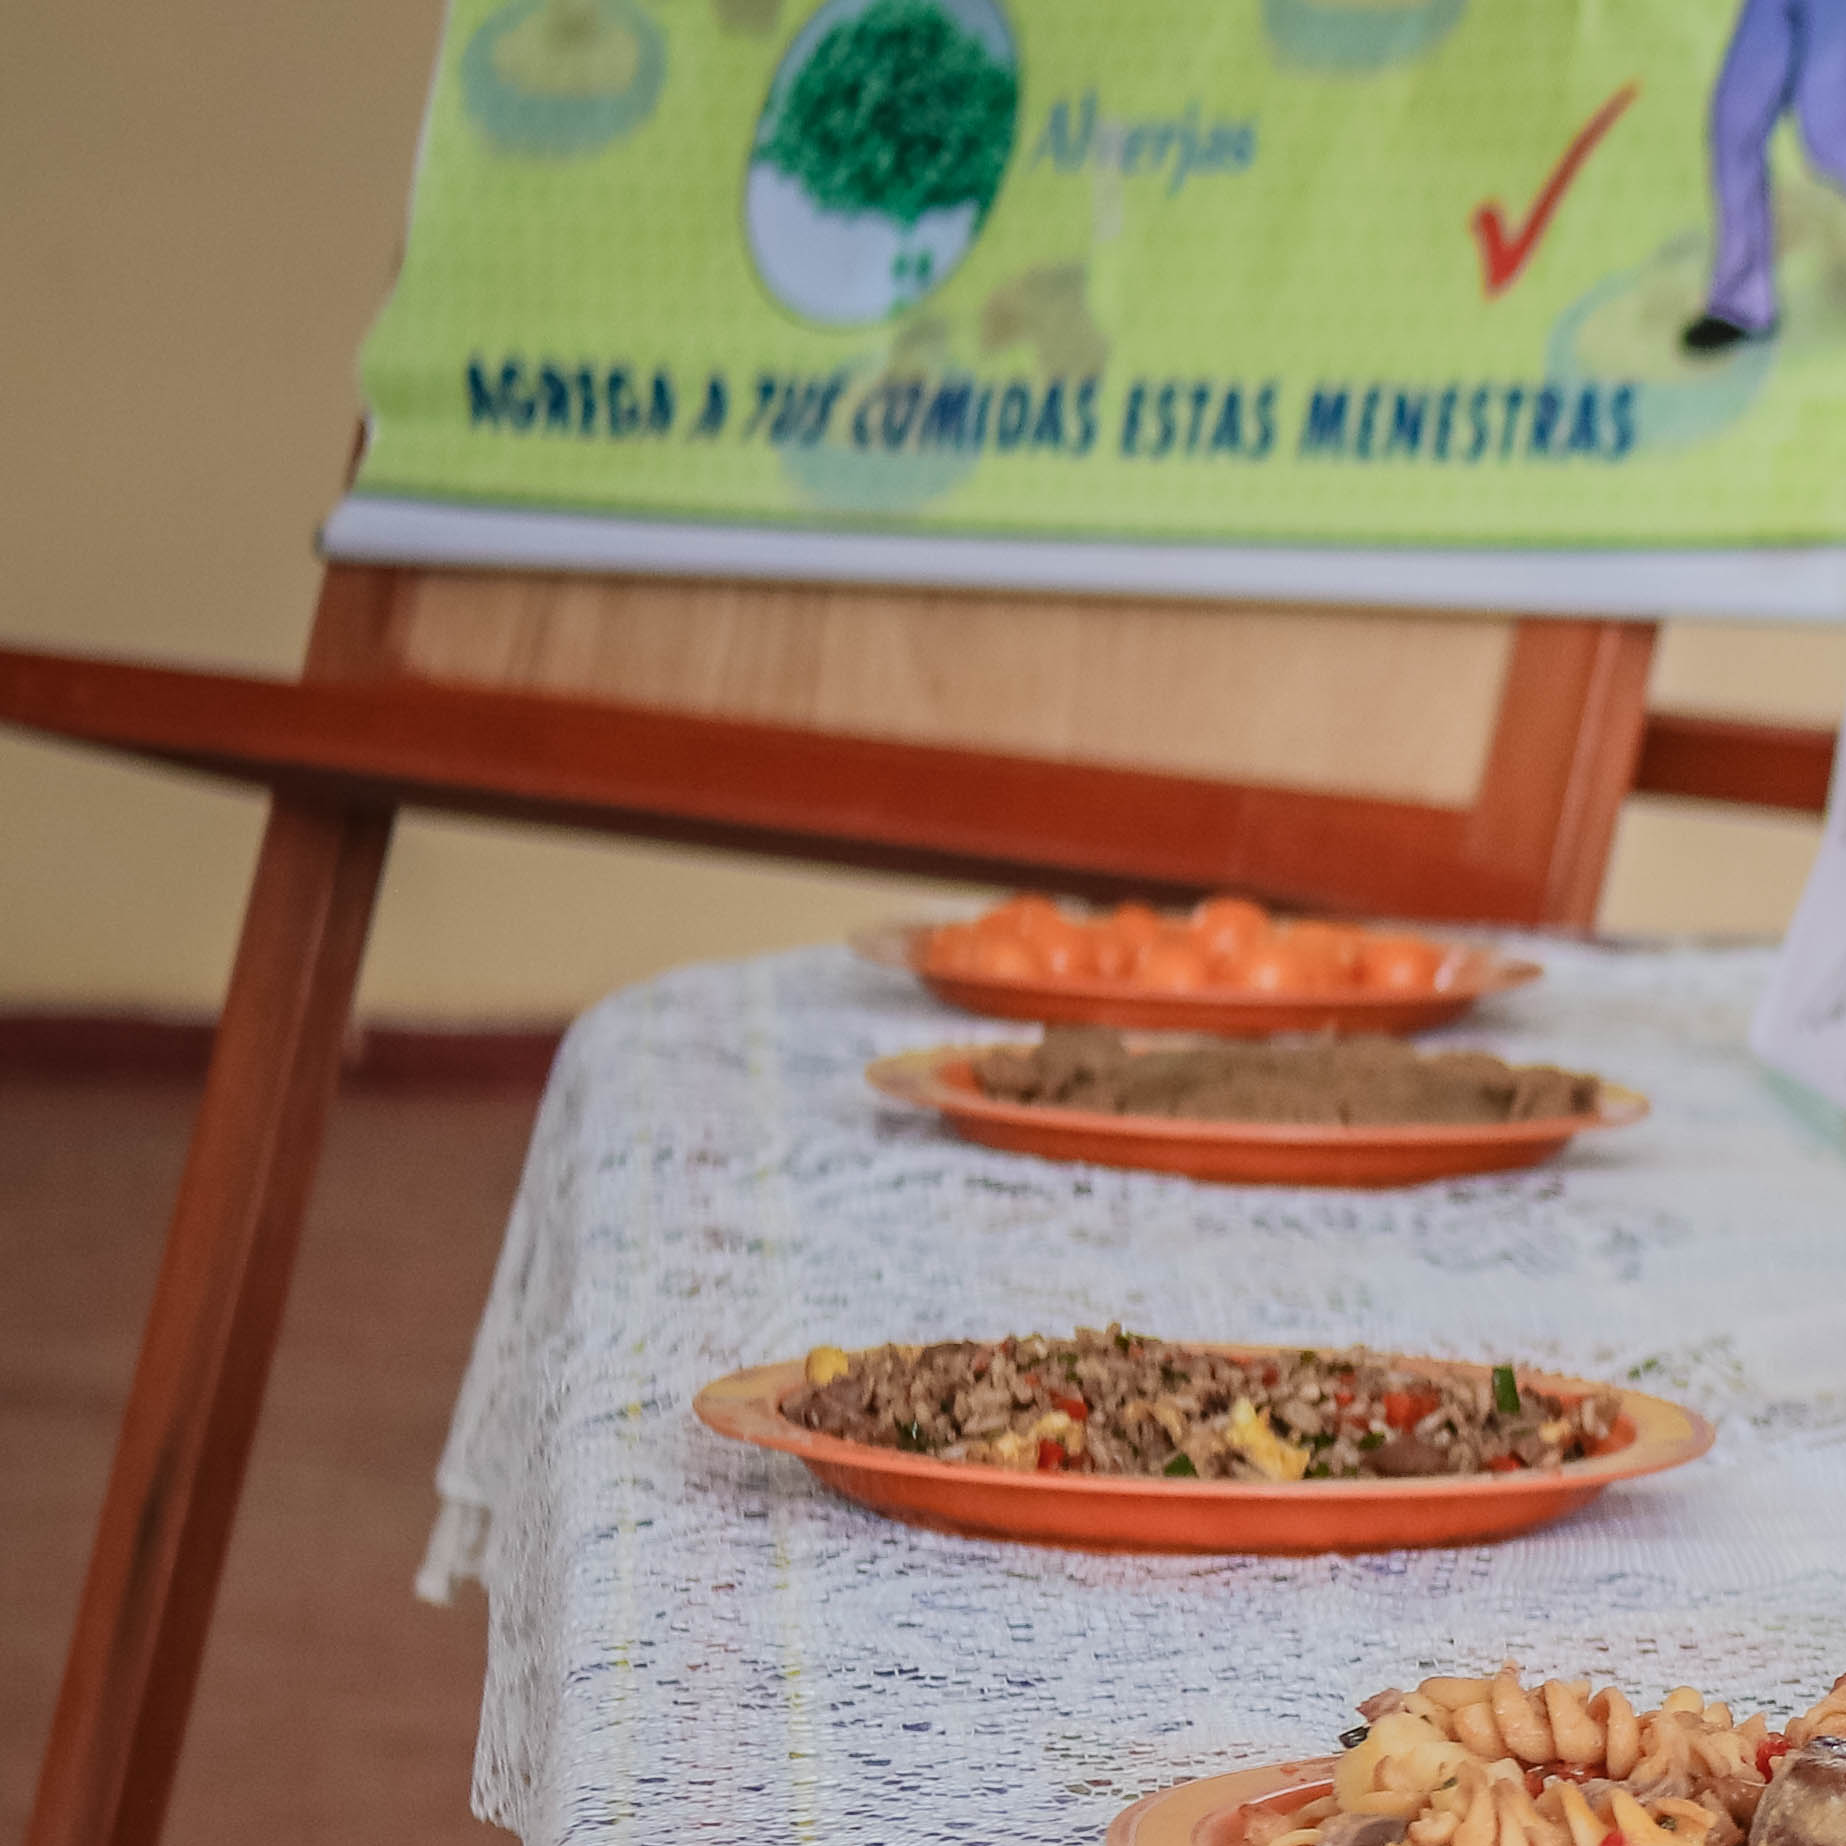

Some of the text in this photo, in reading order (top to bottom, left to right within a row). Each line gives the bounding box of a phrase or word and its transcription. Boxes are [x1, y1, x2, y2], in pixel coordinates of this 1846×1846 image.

[467, 355, 1639, 464] AGREGA A TUS COMIDAS ESTAS MENESTRAS
